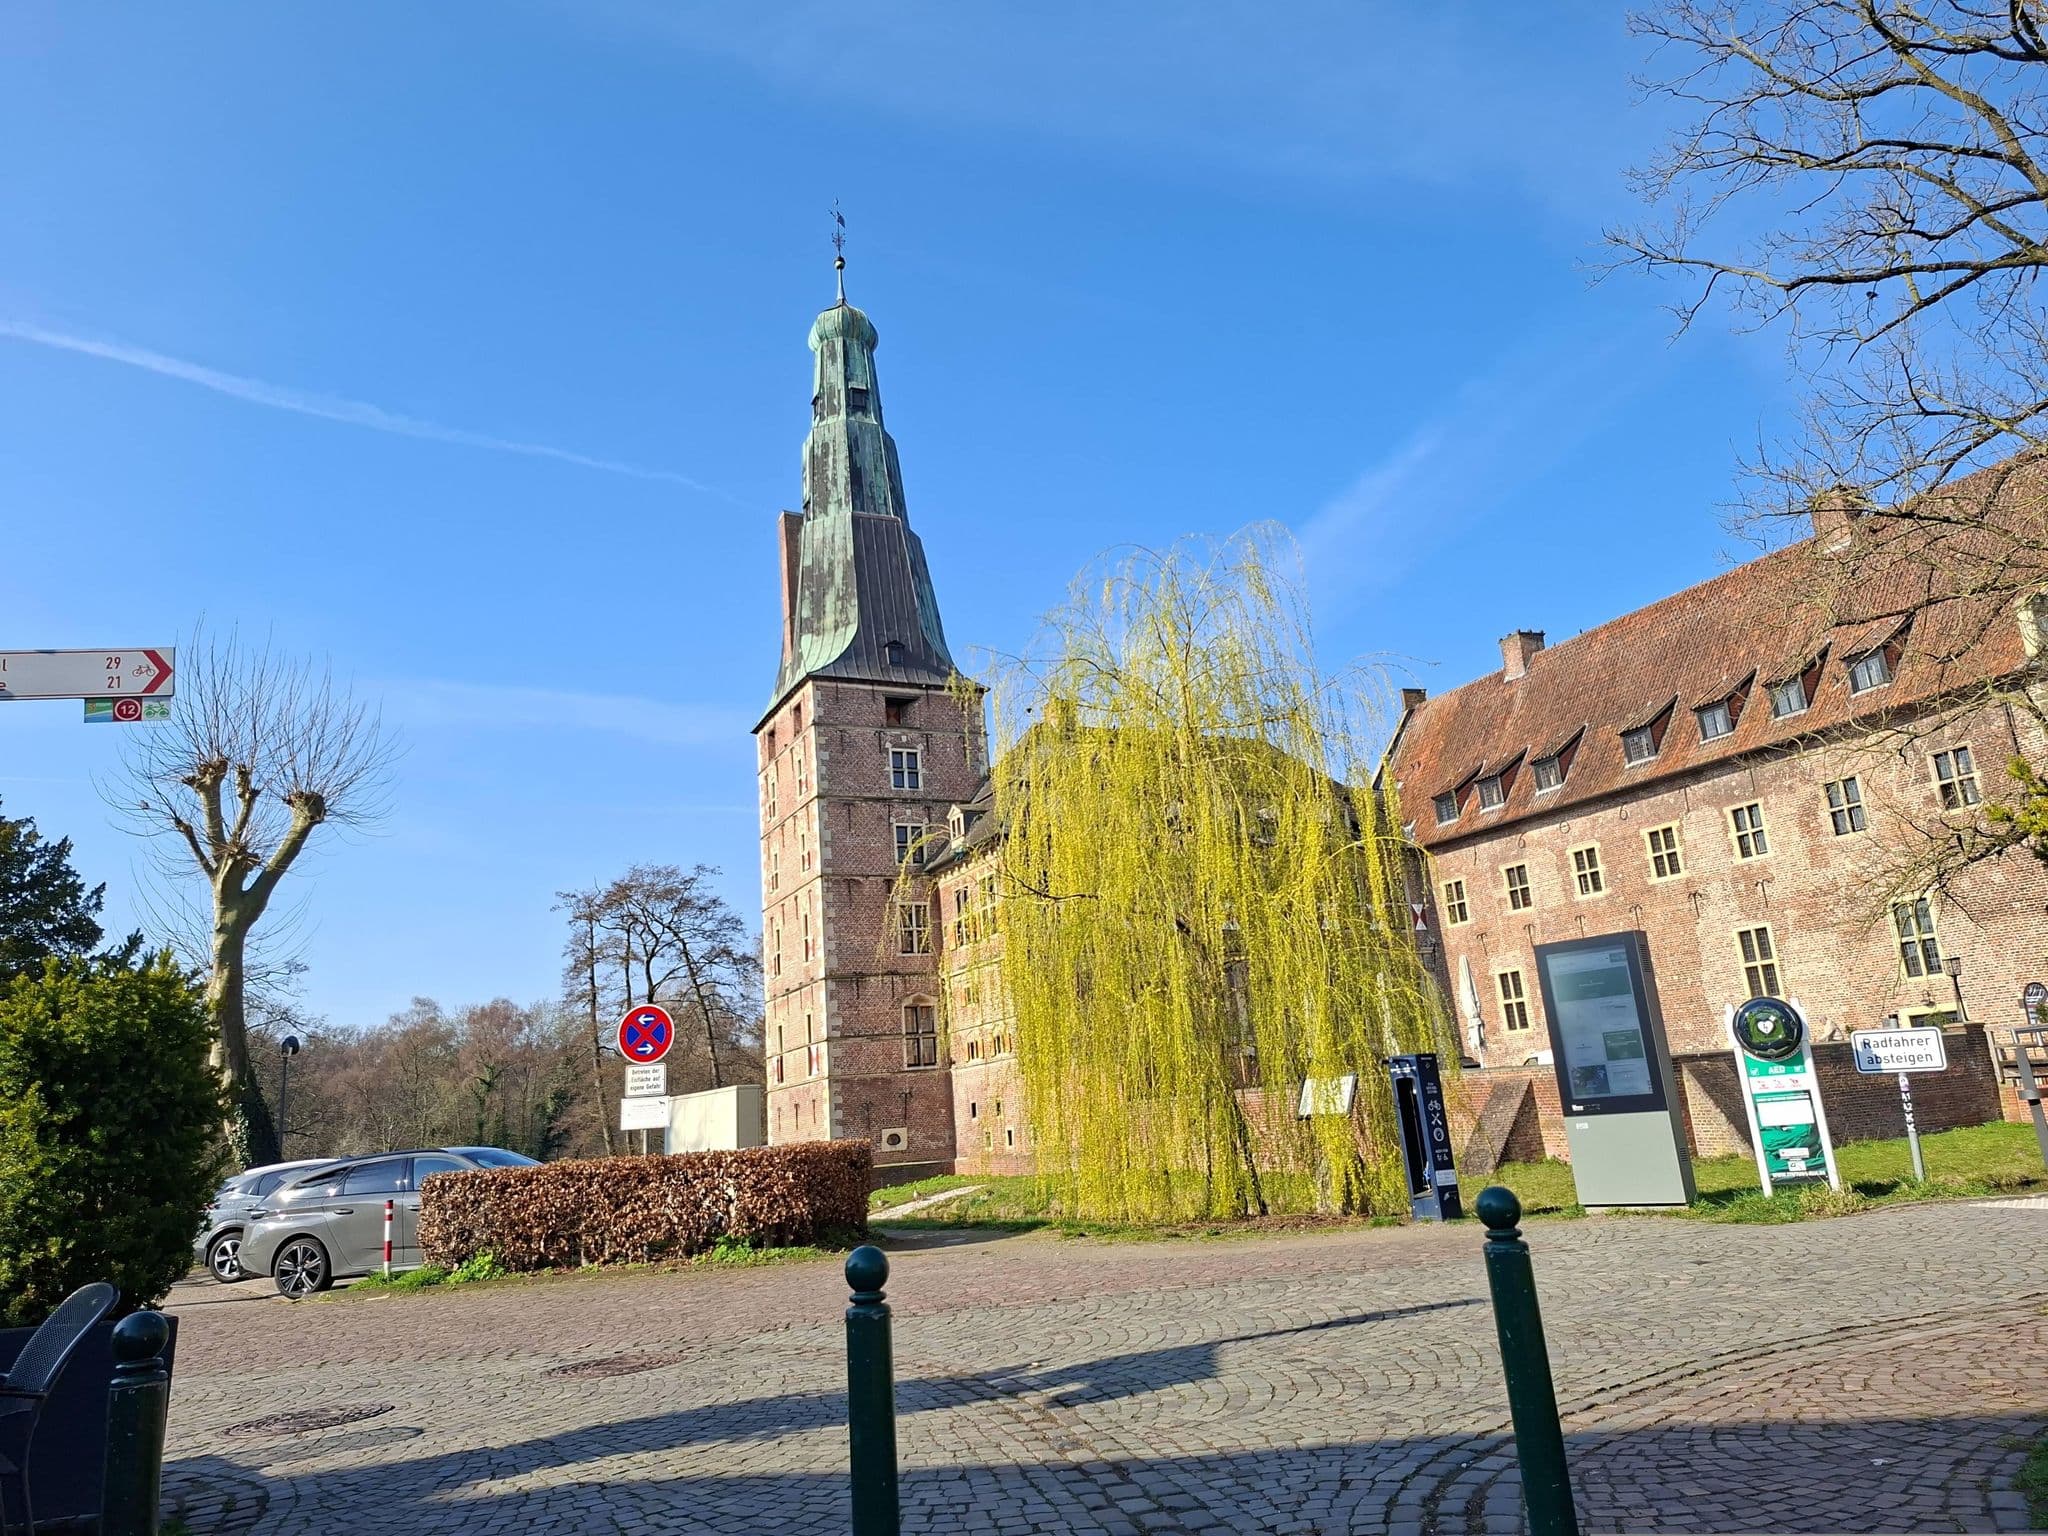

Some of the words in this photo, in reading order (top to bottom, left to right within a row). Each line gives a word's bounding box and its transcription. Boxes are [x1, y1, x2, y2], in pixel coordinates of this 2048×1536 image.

[106, 656, 121, 670] 29
[107, 675, 121, 689] 21
[120, 704, 136, 715] 12
[1862, 1036, 1931, 1049] Radfahrer
[1866, 1052, 1933, 1066] absteigen
